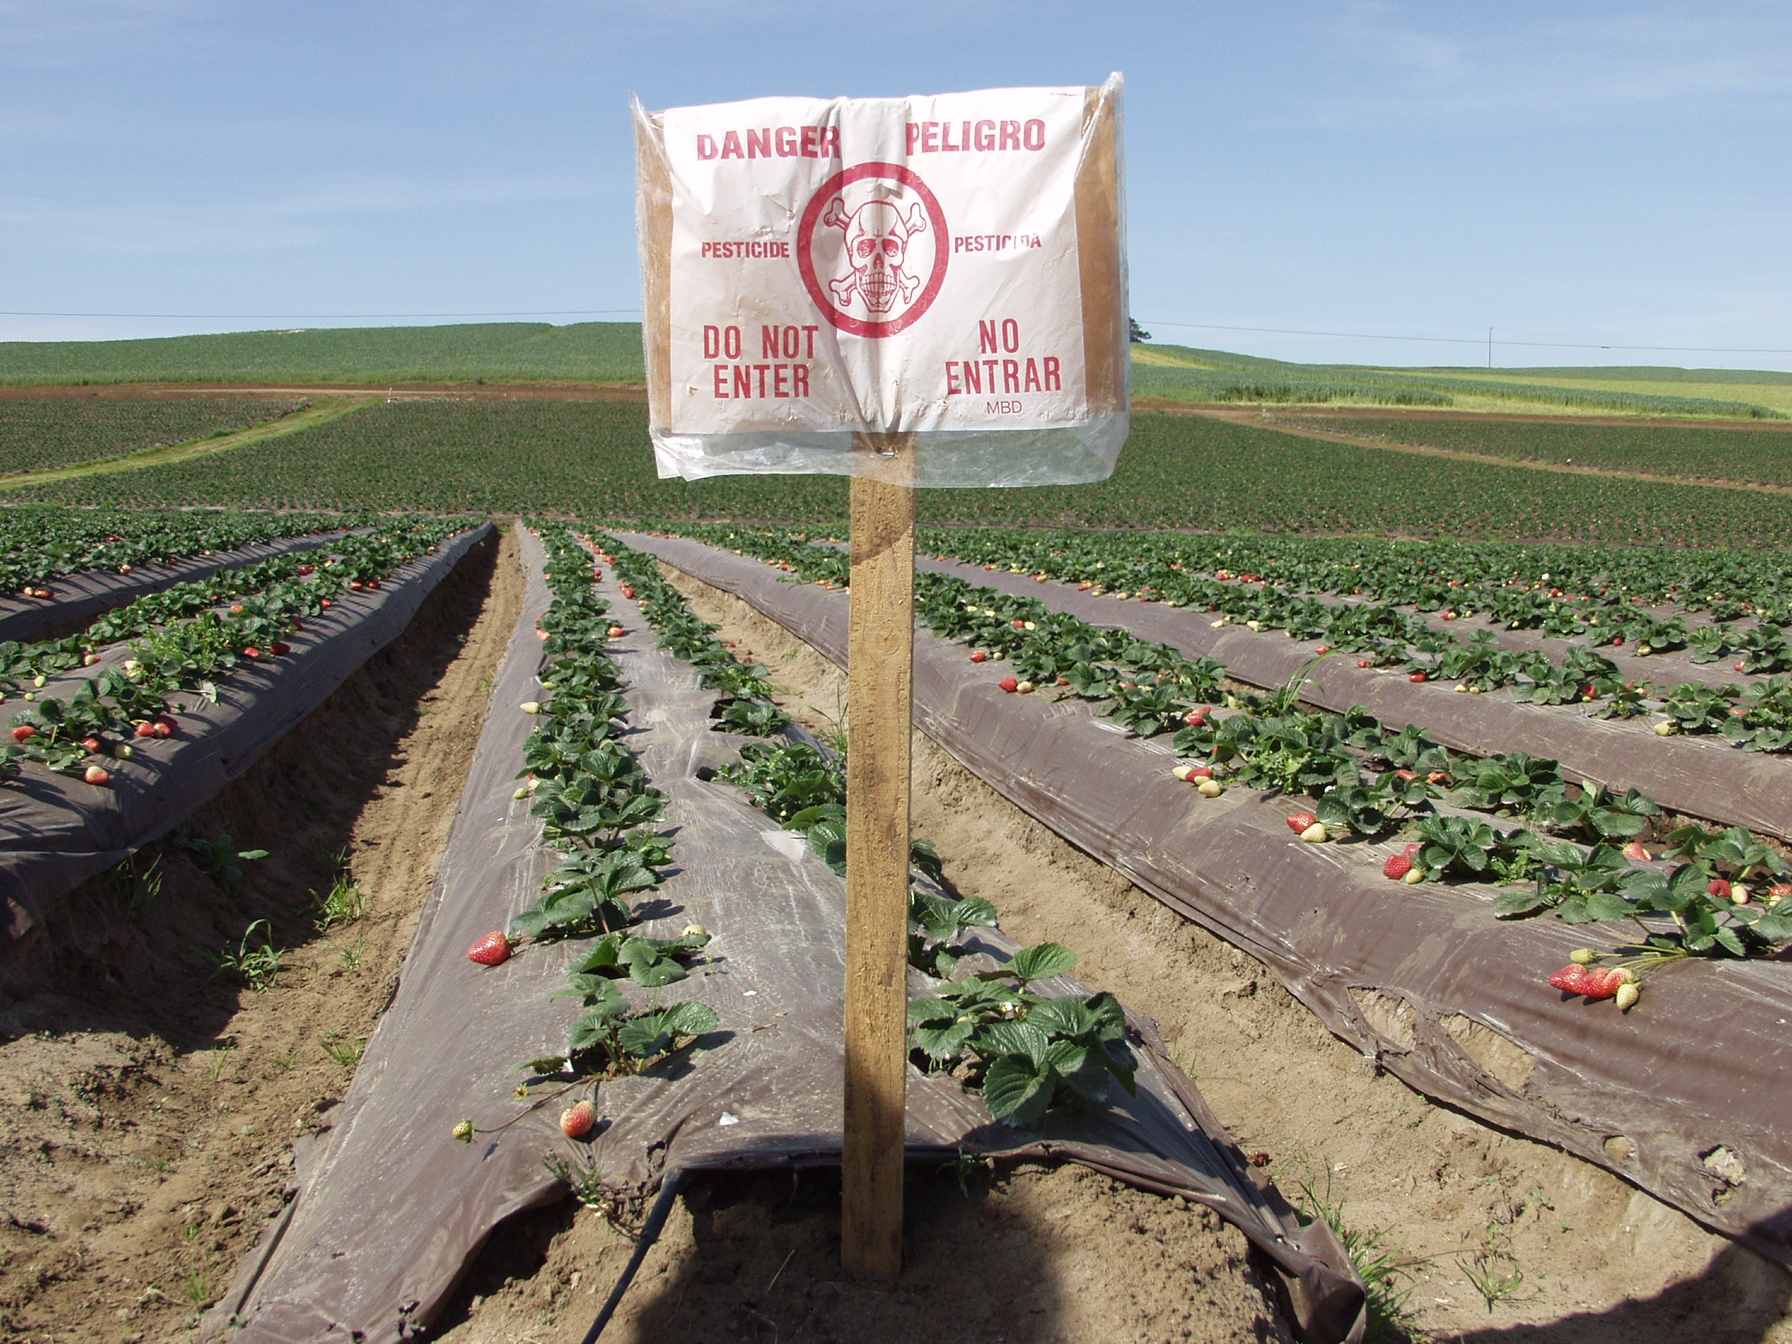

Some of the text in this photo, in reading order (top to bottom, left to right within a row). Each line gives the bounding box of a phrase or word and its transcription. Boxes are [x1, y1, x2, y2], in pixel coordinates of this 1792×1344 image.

[697, 126, 841, 161] DANGER
[905, 118, 1046, 156] PELIGRO
[701, 241, 790, 259] PESTICIDE
[703, 325, 820, 360] DO NOT
[979, 318, 1020, 355] NO
[714, 364, 810, 399] ENTER
[946, 356, 1062, 396] ENTRAR
[986, 400, 1023, 415] MBD
